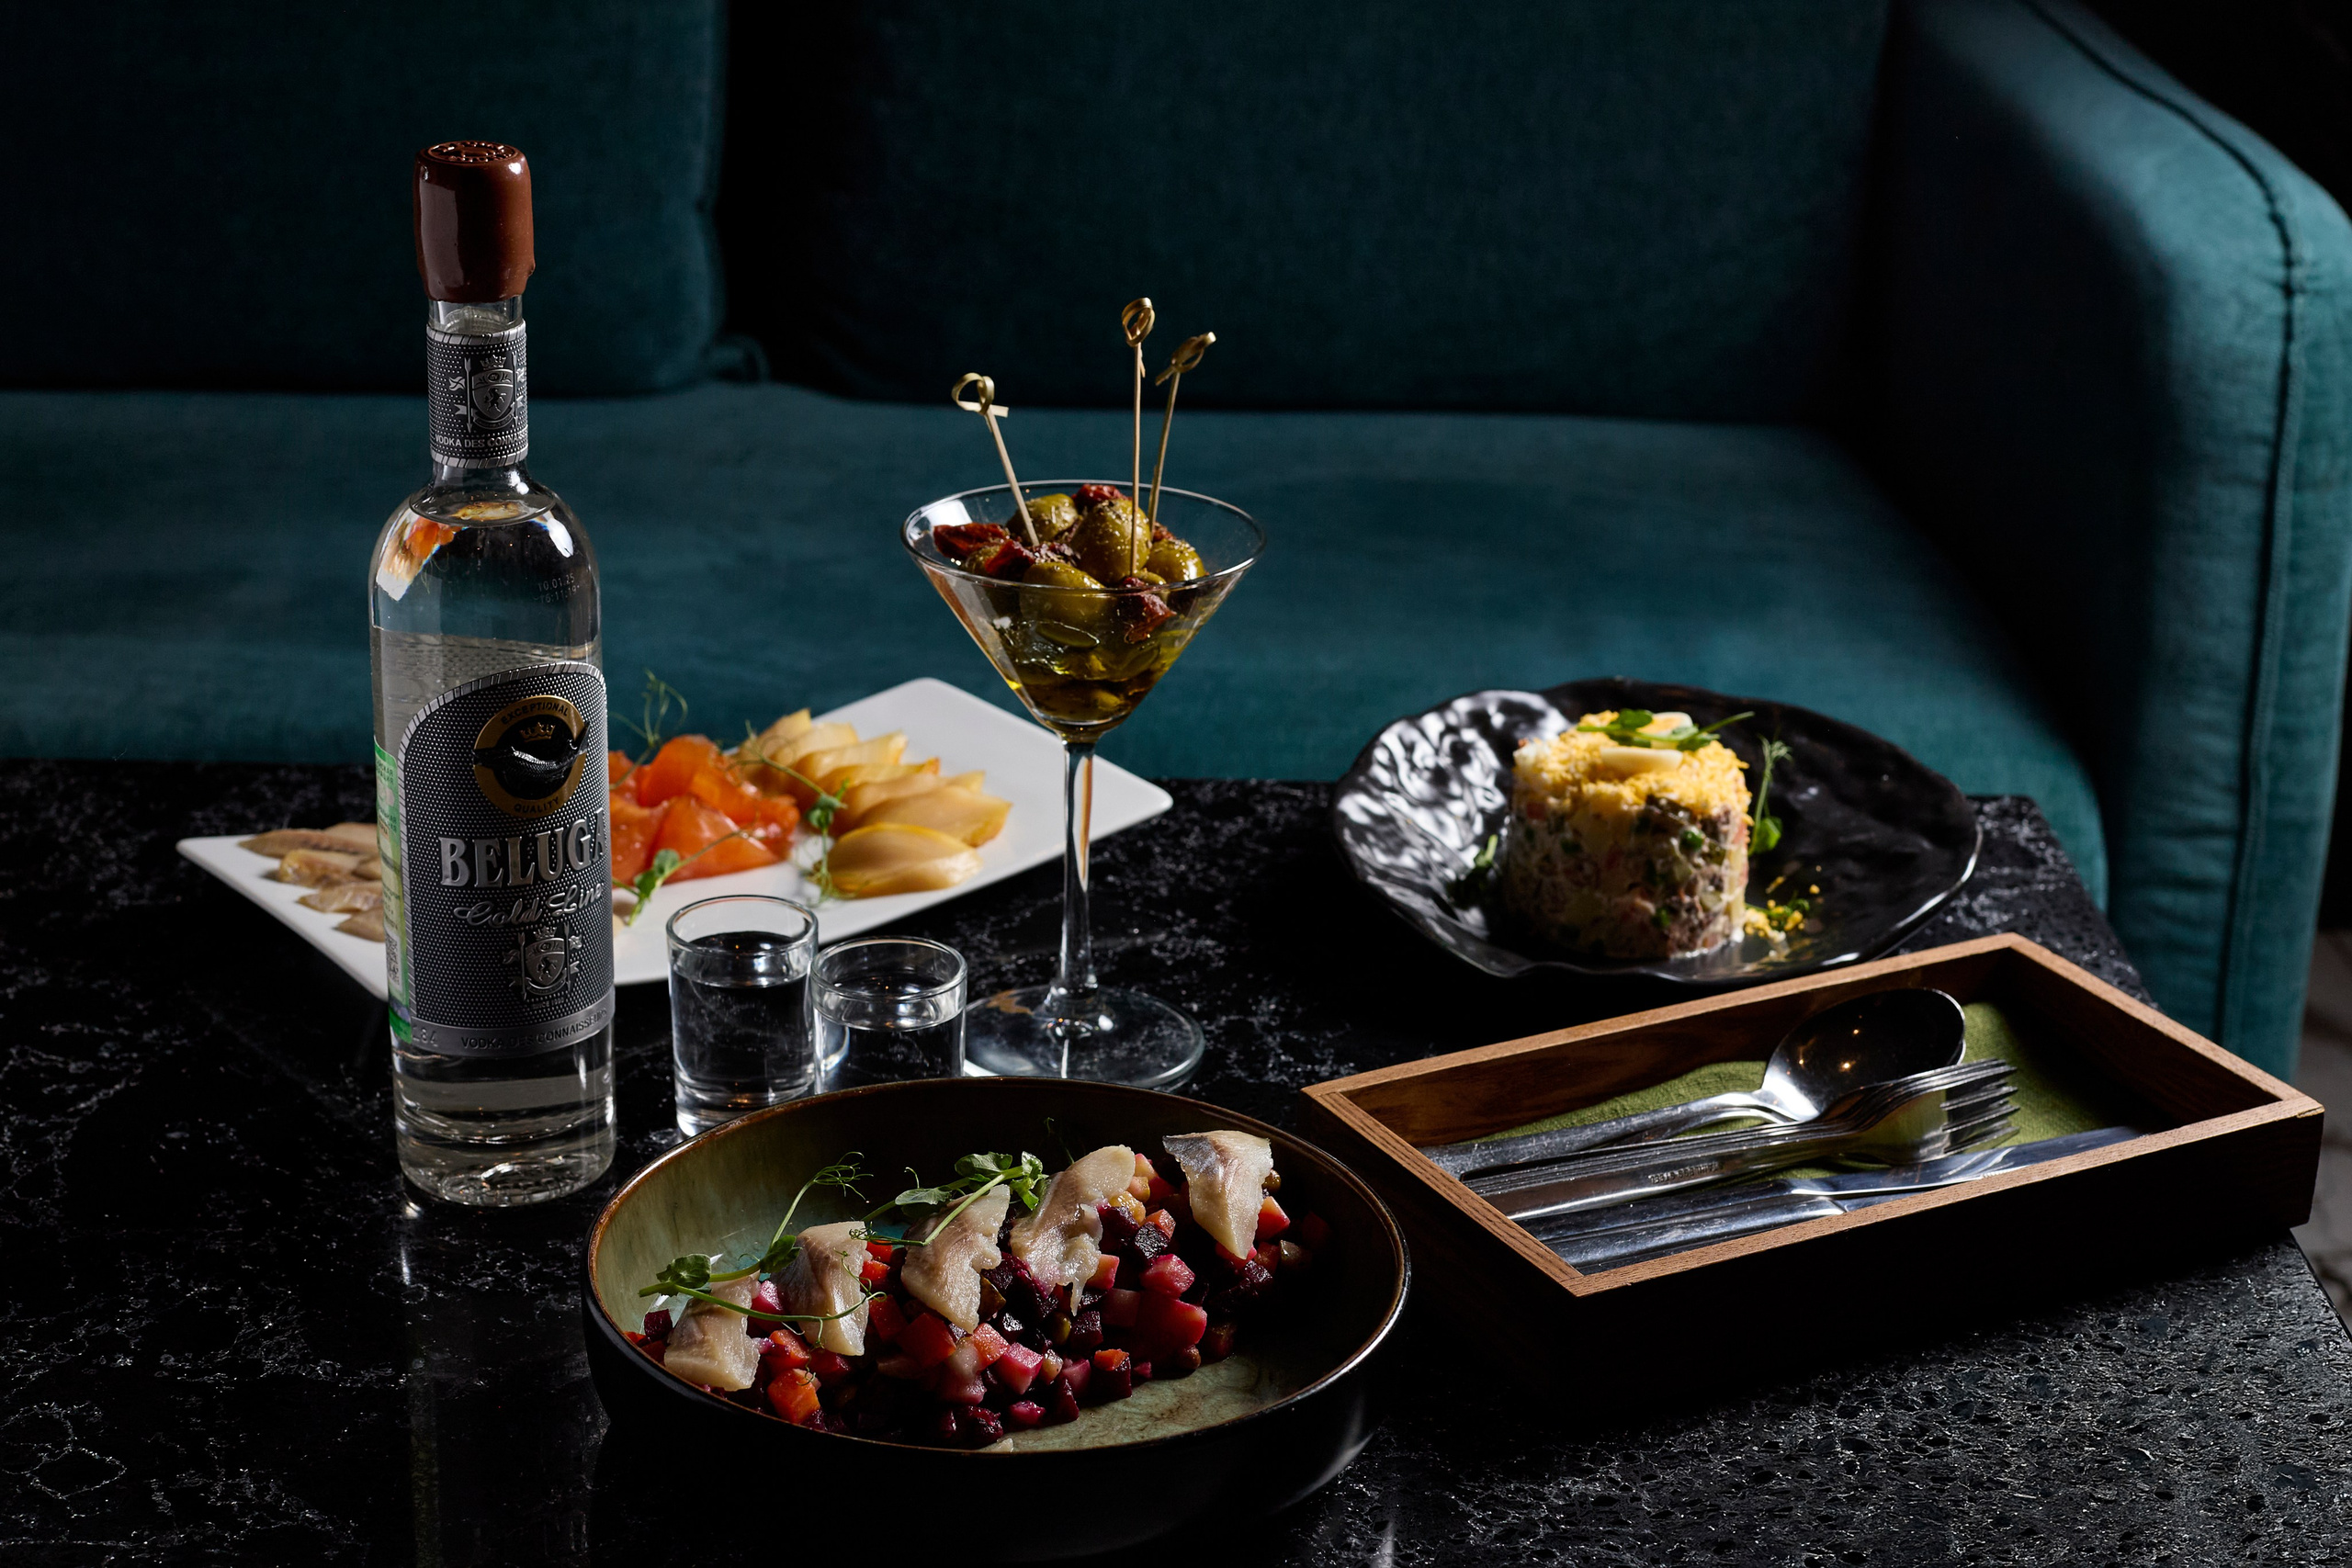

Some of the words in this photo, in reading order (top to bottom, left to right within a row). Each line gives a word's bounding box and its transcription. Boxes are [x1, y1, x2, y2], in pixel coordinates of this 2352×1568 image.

[435, 434, 462, 447] VODKA
[464, 438, 485, 448] DES
[501, 701, 569, 725] EXCEPTIONAL
[514, 796, 560, 814] QUALITY
[438, 807, 607, 888] BELUGA
[453, 897, 544, 928] Gold
[546, 883, 604, 917] Line
[460, 1035, 506, 1050] VODKA
[508, 1033, 534, 1048] DES
[536, 1007, 607, 1044] CONNAISSEURS
[1647, 1171, 1676, 1185] STEEL
